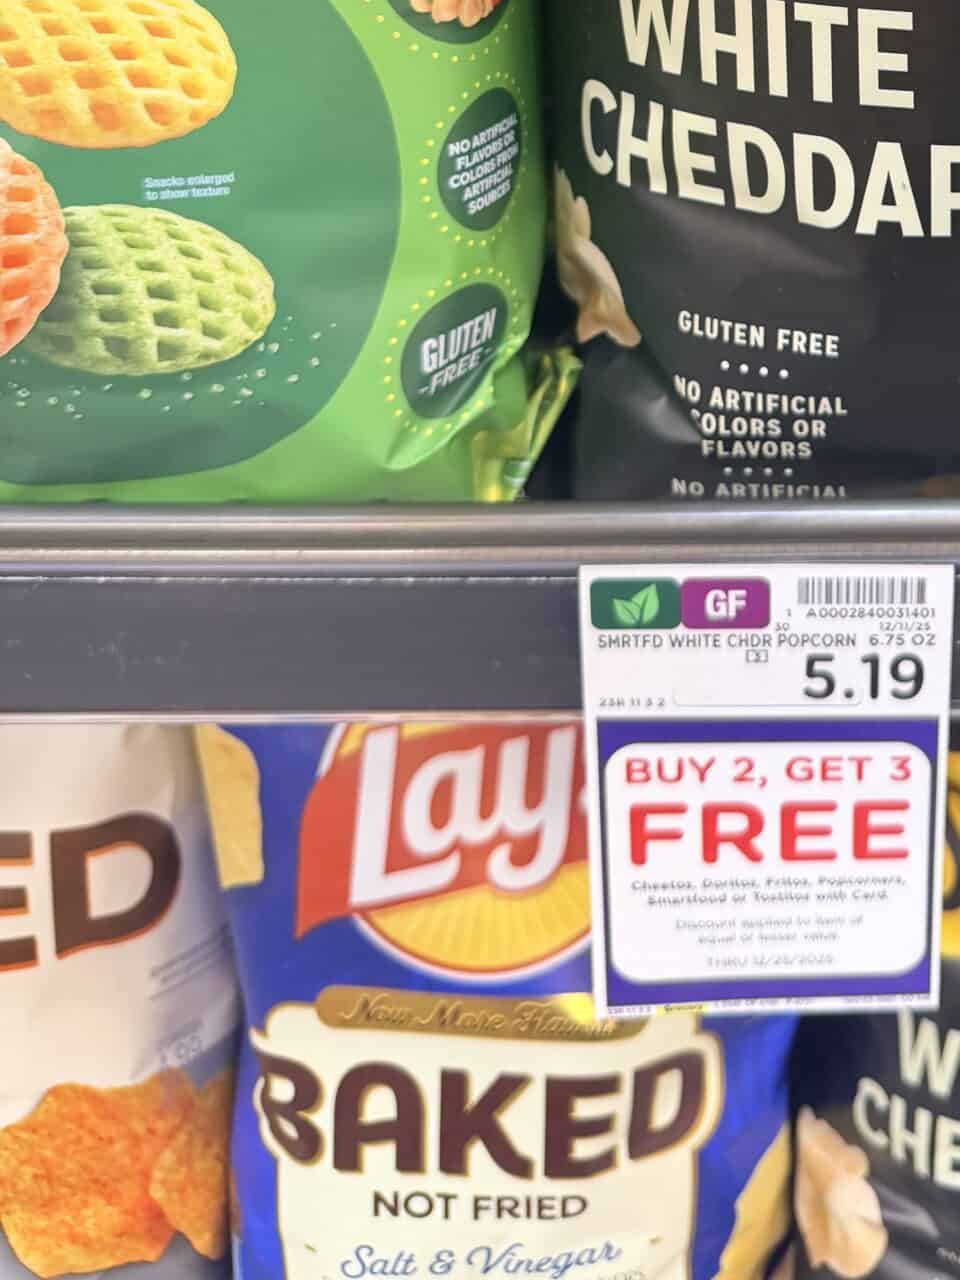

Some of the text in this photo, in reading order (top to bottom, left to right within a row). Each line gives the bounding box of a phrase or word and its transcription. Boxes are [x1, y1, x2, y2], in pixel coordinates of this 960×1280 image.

[448, 139, 470, 157] NO
[455, 140, 503, 171] FLAVORS
[448, 157, 496, 189] COLORS
[421, 307, 497, 374] GLUTEN
[678, 310, 839, 357] GLUTEN FREE
[430, 348, 481, 396] FREE
[674, 374, 848, 416] NO ARTIFICIAL
[793, 419, 826, 438] OR
[702, 439, 813, 459] FLAVORS
[671, 477, 705, 496] NO
[704, 589, 747, 620] GF
[598, 633, 937, 649] SMRTFD WHITE CHDR POPCORN 6.75 OZ
[803, 653, 924, 700] 5.19
[625, 756, 911, 787] BUY 2, GET 3
[629, 800, 910, 865] FREE
[257, 1049, 704, 1180] BAKED
[374, 1191, 588, 1220] NOT FRIED
[341, 1240, 623, 1279] Salt & Vinegar
